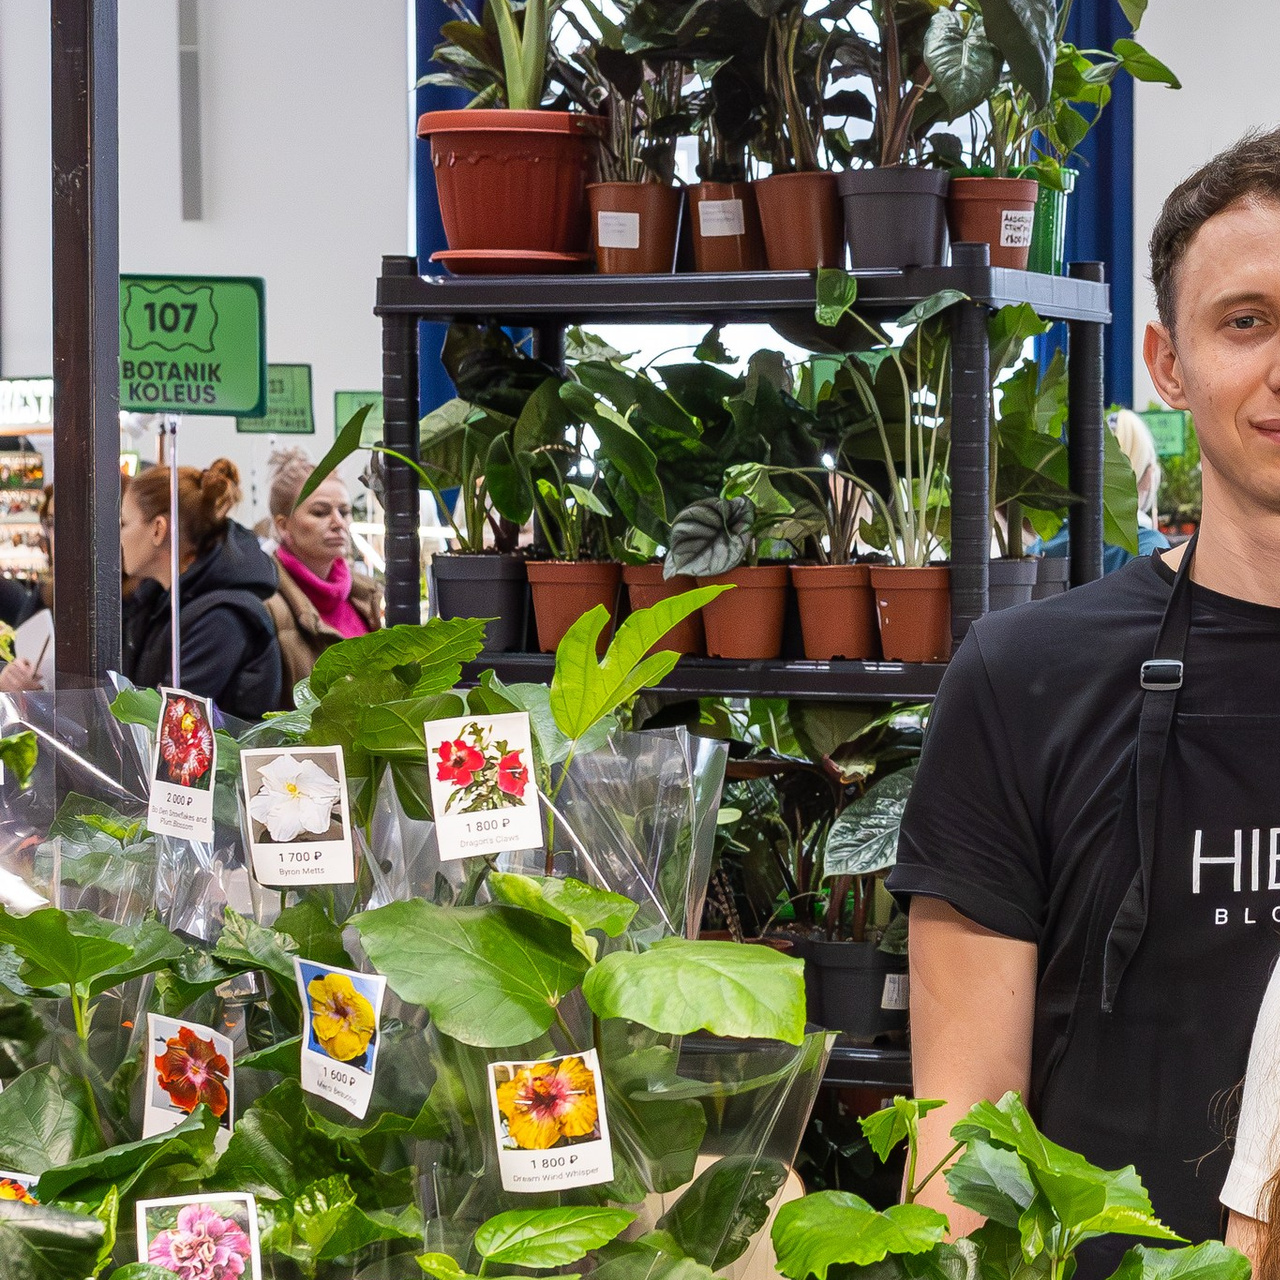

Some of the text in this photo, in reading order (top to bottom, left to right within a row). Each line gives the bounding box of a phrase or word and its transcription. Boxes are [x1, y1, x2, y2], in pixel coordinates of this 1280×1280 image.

[144, 302, 198, 333] 107
[122, 361, 221, 384] BOTANIK
[128, 382, 216, 404] KOLEUS
[172, 794, 186, 806] 000
[476, 819, 498, 832] 800
[460, 833, 520, 849] Dragon's Claws
[288, 851, 311, 863] 700
[279, 866, 326, 877] Byron Metts
[331, 1069, 347, 1085] 600
[542, 1157, 566, 1169] 800
[513, 1166, 600, 1184] Dream Wind Whisper
